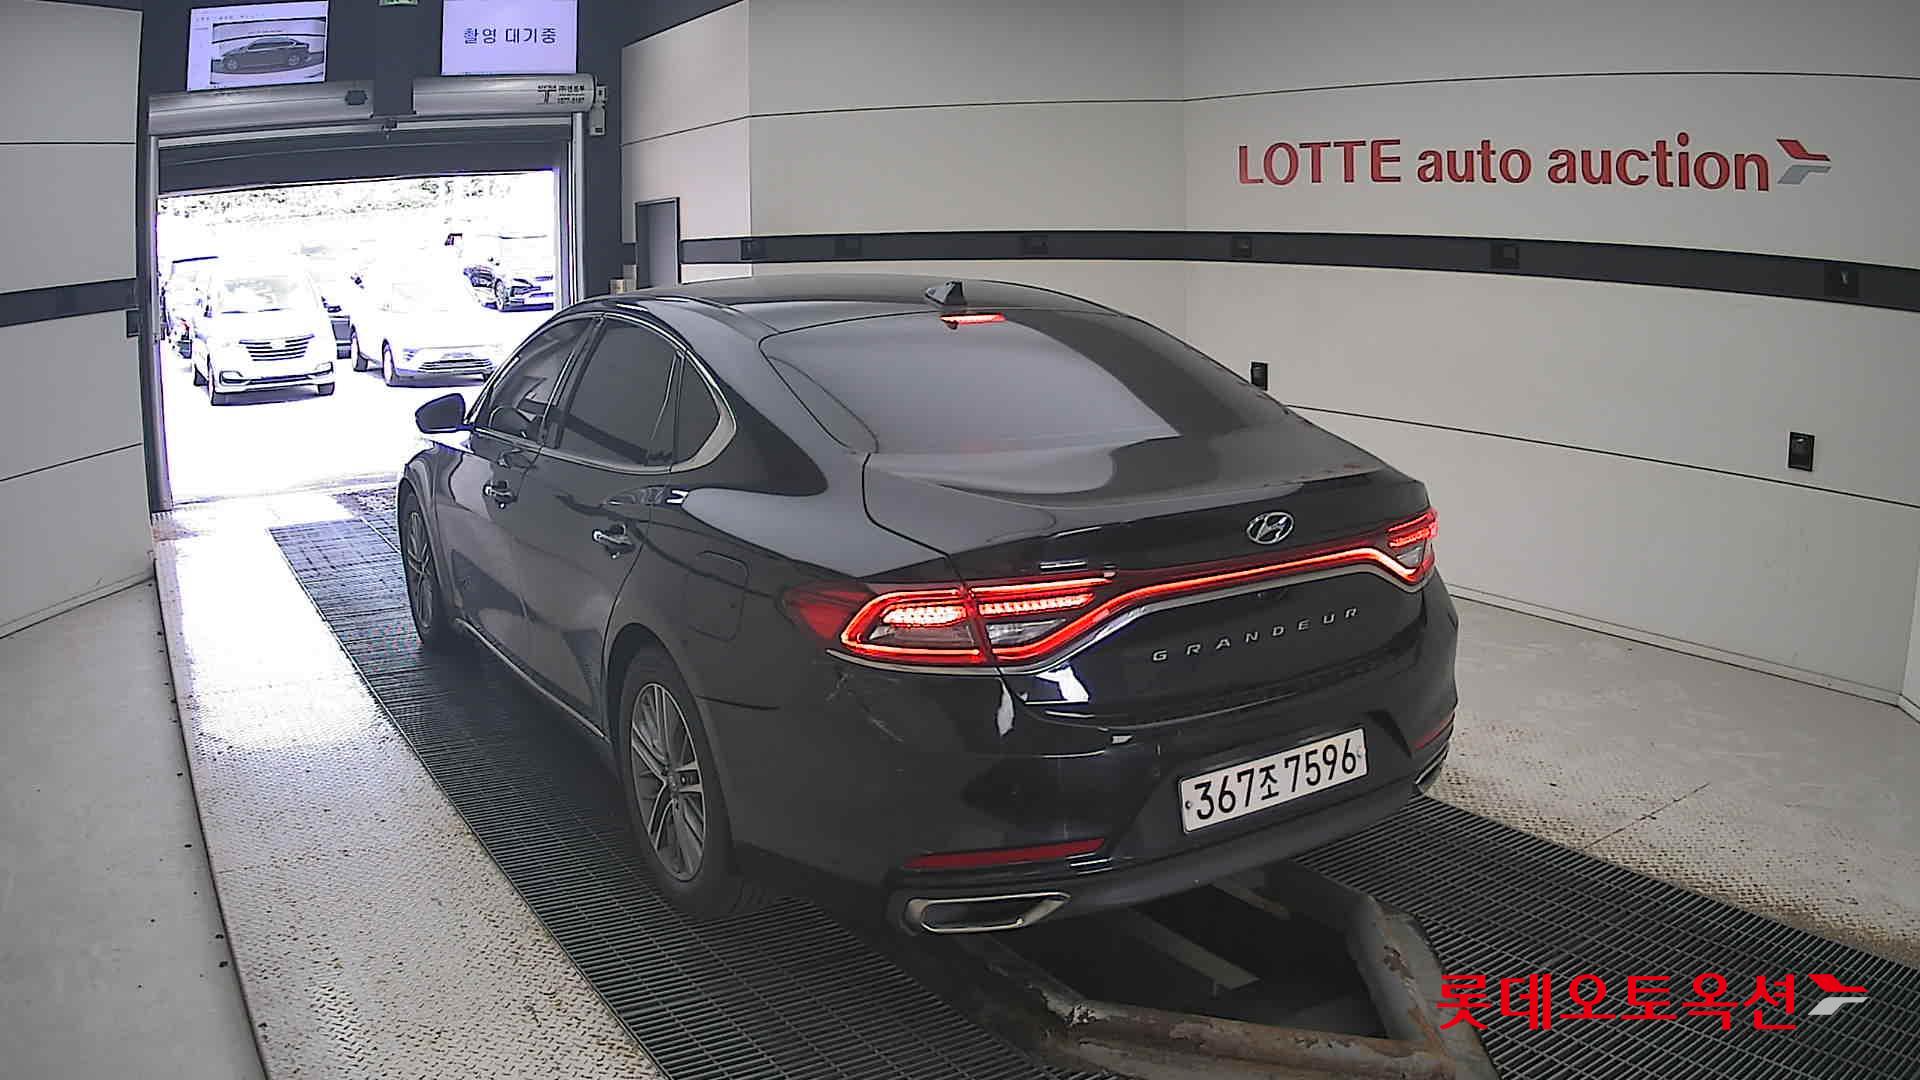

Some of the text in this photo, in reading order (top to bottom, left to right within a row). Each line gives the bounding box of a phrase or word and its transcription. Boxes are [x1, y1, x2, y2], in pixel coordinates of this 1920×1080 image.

[464, 27, 557, 45] 촬영 대기중
[1238, 131, 1769, 192] LOTTE auto auction
[1152, 607, 1358, 662] GRANDEUR
